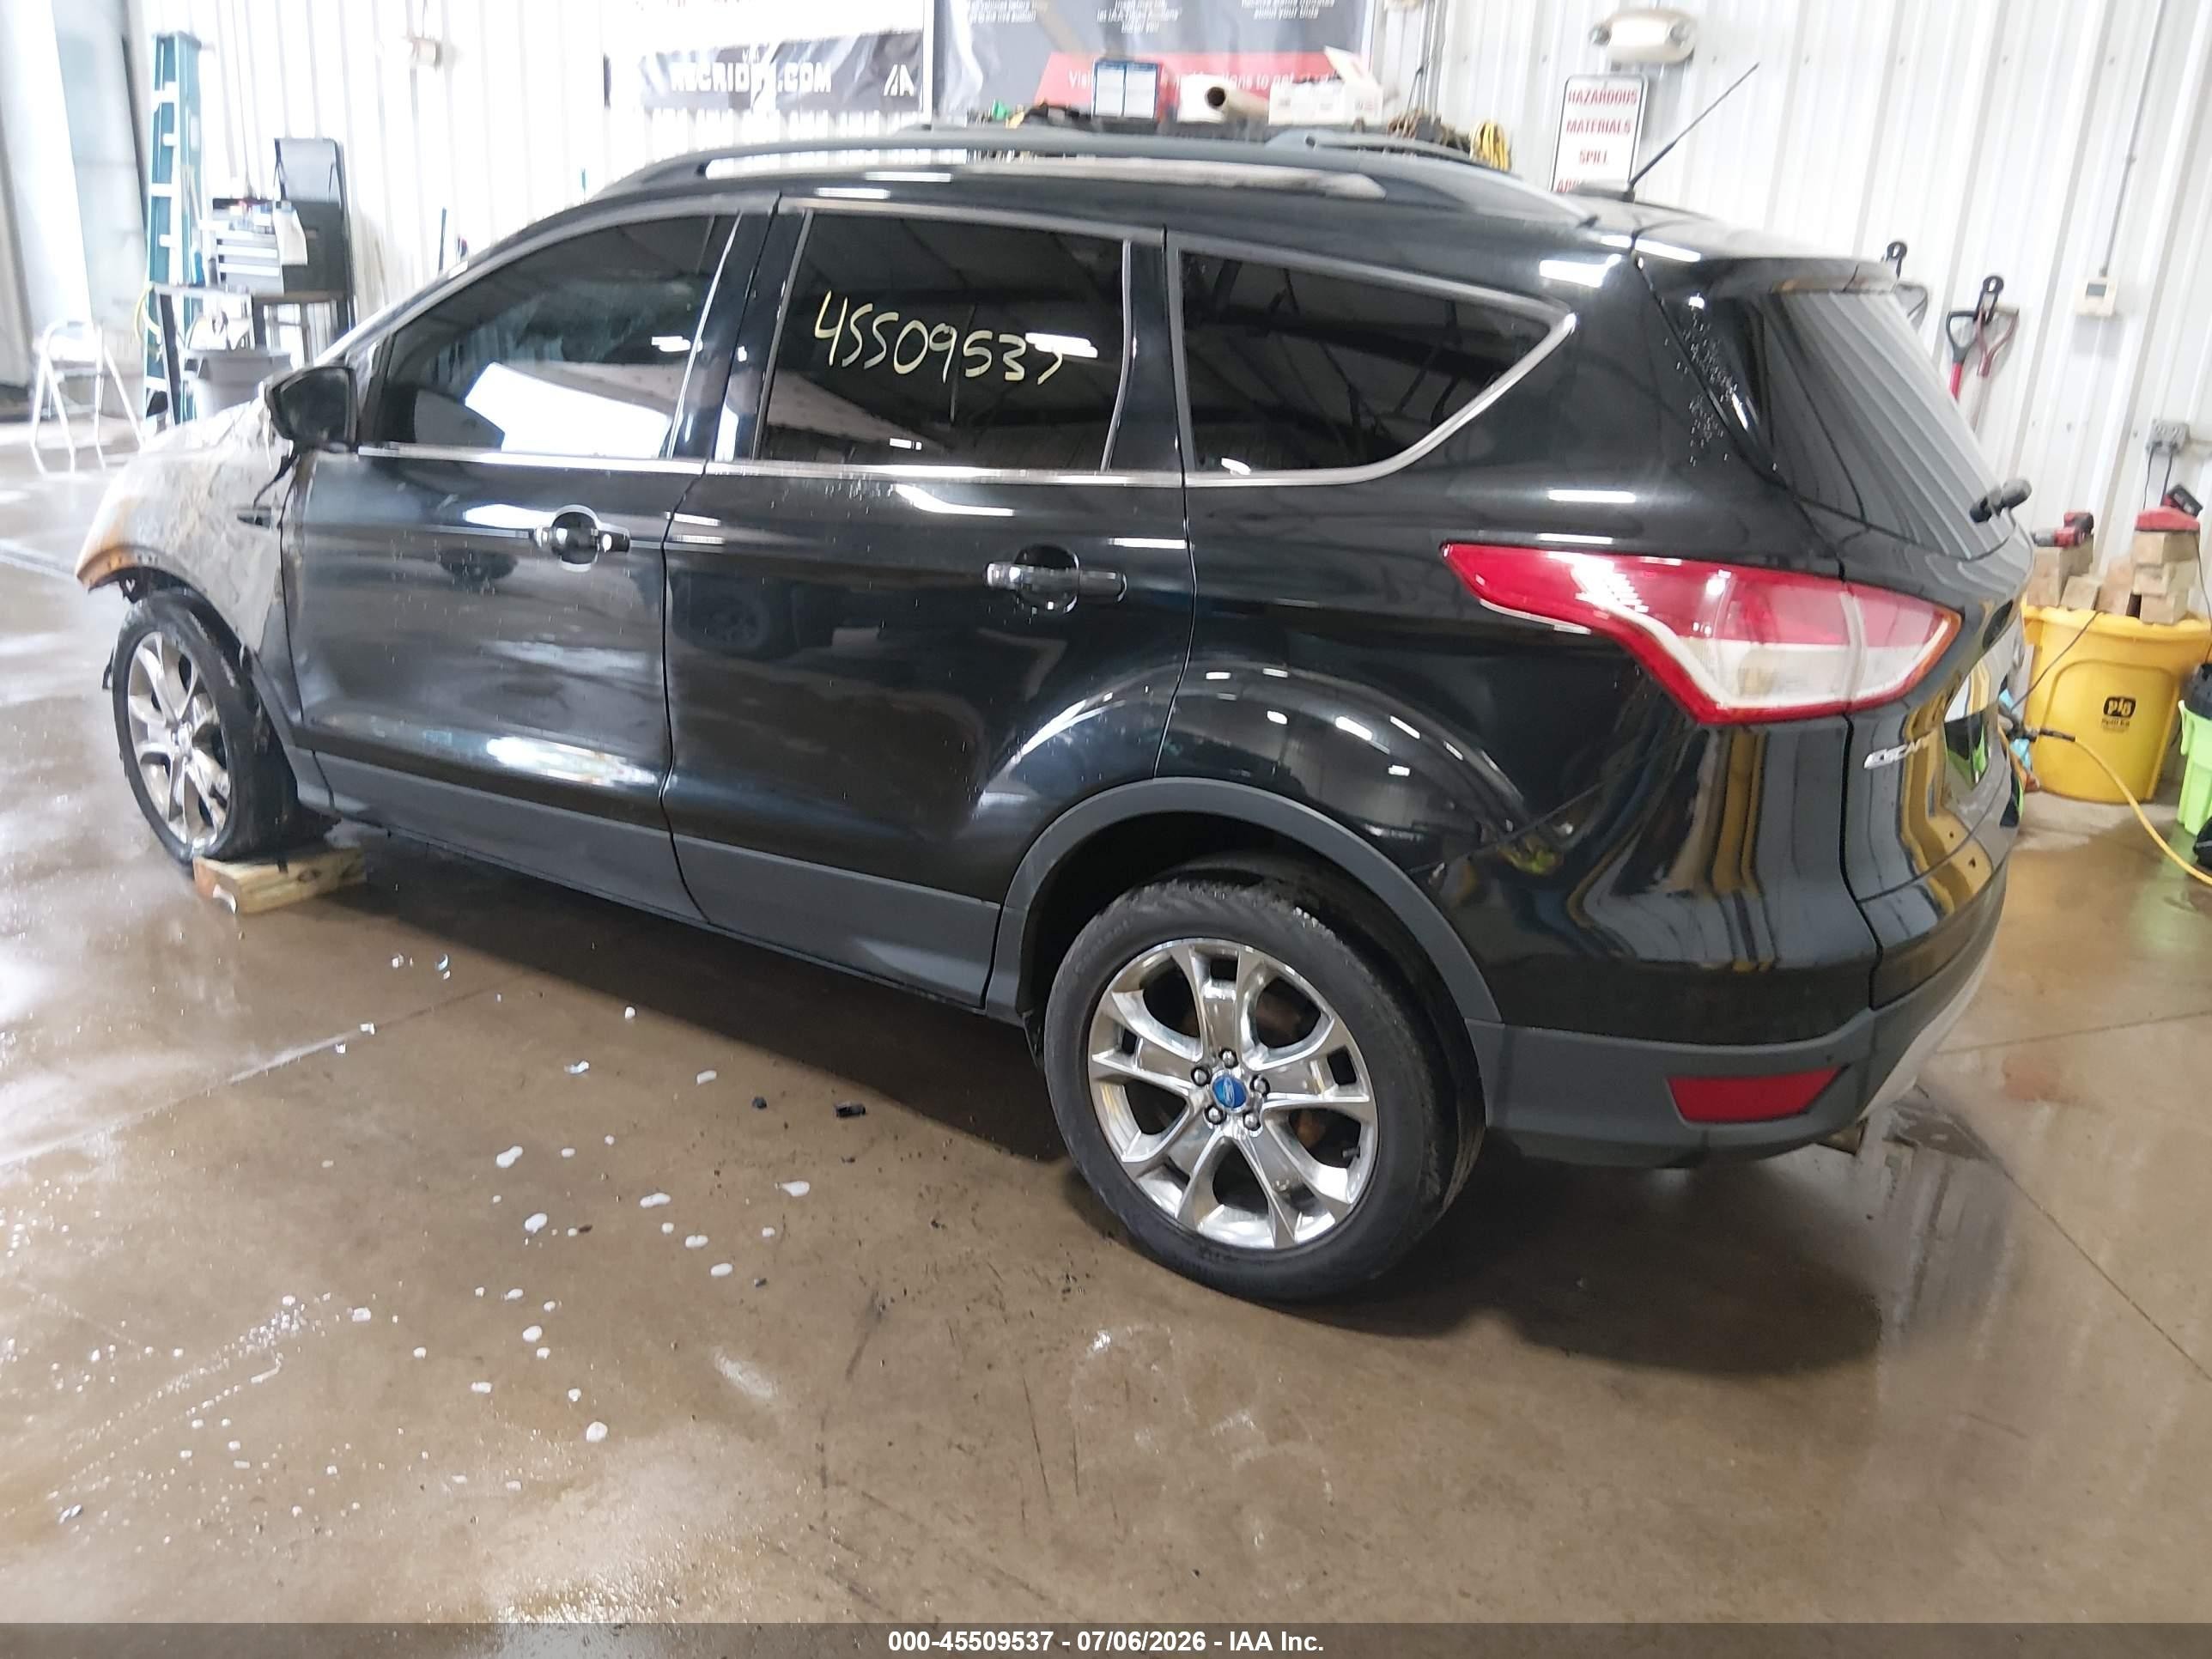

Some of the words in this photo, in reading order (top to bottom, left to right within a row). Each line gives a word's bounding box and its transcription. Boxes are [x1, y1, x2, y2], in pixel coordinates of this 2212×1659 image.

[1568, 89, 1638, 105] HAZARDOUS
[1566, 118, 1632, 136] MATERIALS
[1579, 149, 1608, 165] SPILL
